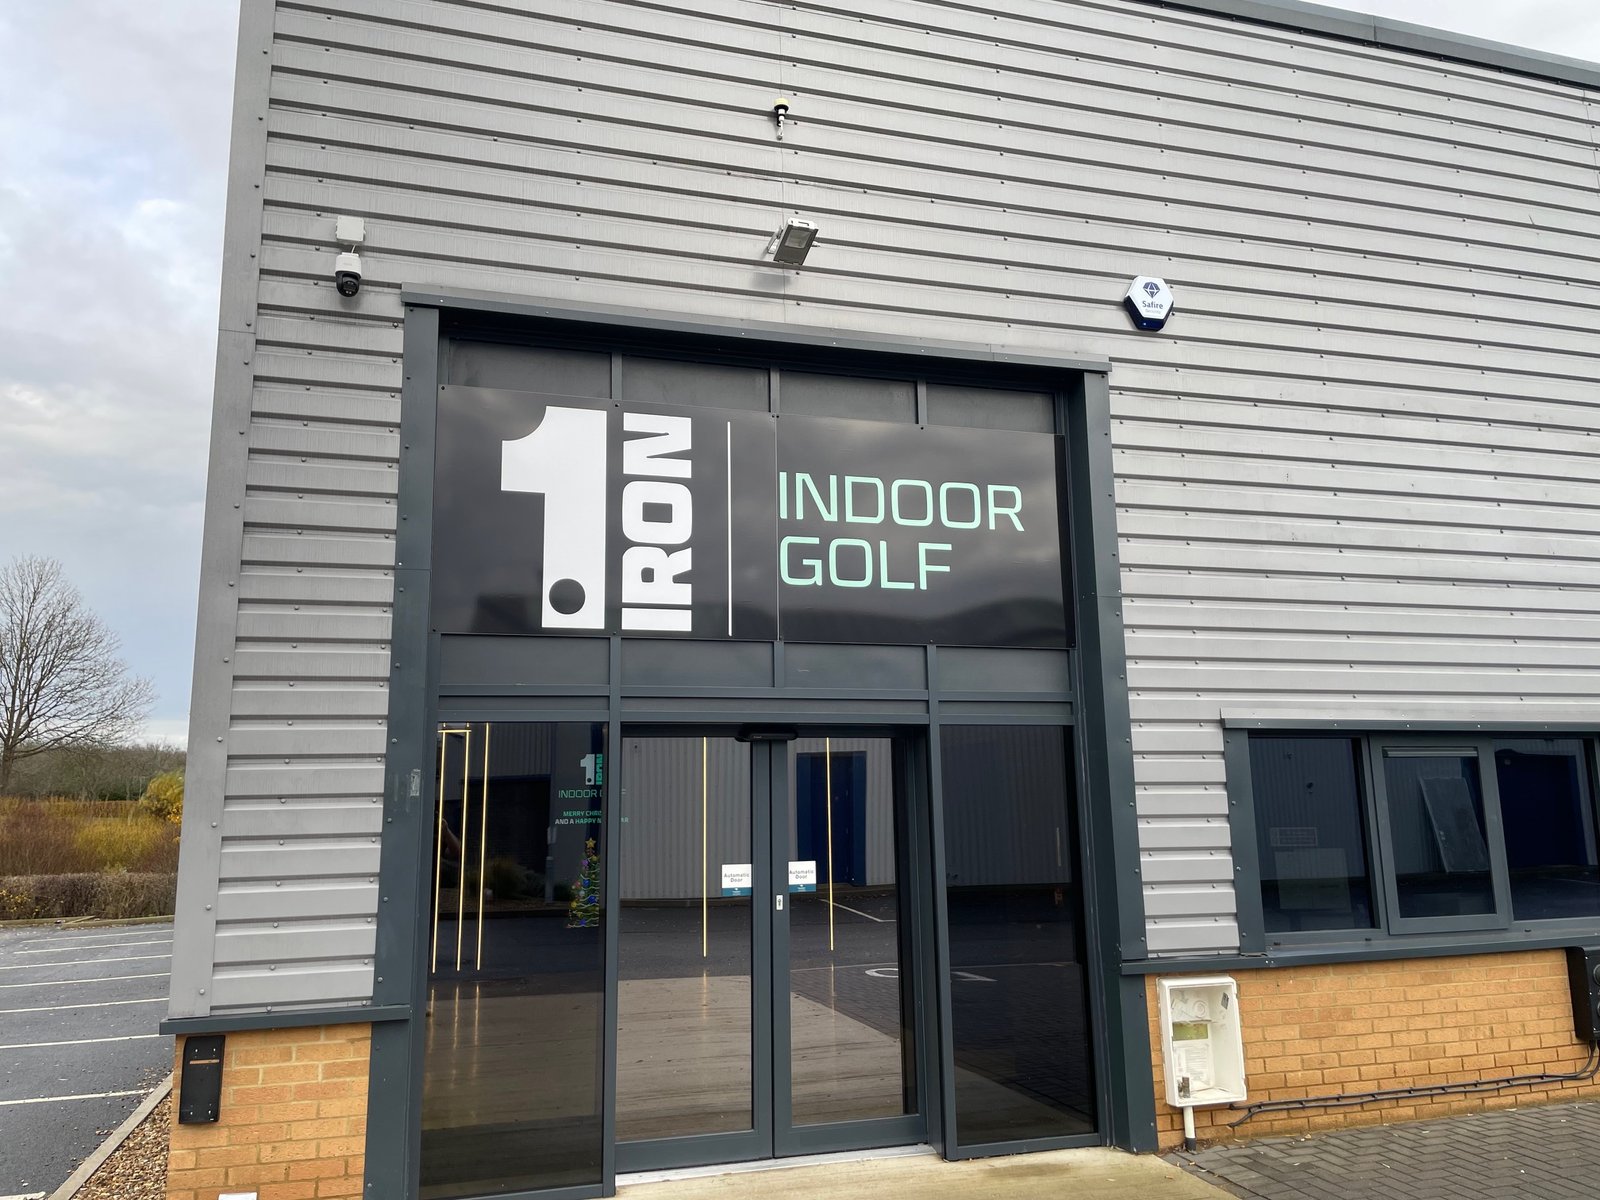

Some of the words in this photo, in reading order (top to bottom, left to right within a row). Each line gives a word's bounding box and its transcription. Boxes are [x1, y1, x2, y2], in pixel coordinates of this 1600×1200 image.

[1142, 300, 1164, 310] Safire
[621, 412, 692, 632] IRON
[778, 471, 1025, 532] INDOOR
[779, 535, 953, 590] GOLF
[558, 790, 597, 798] INDOOR
